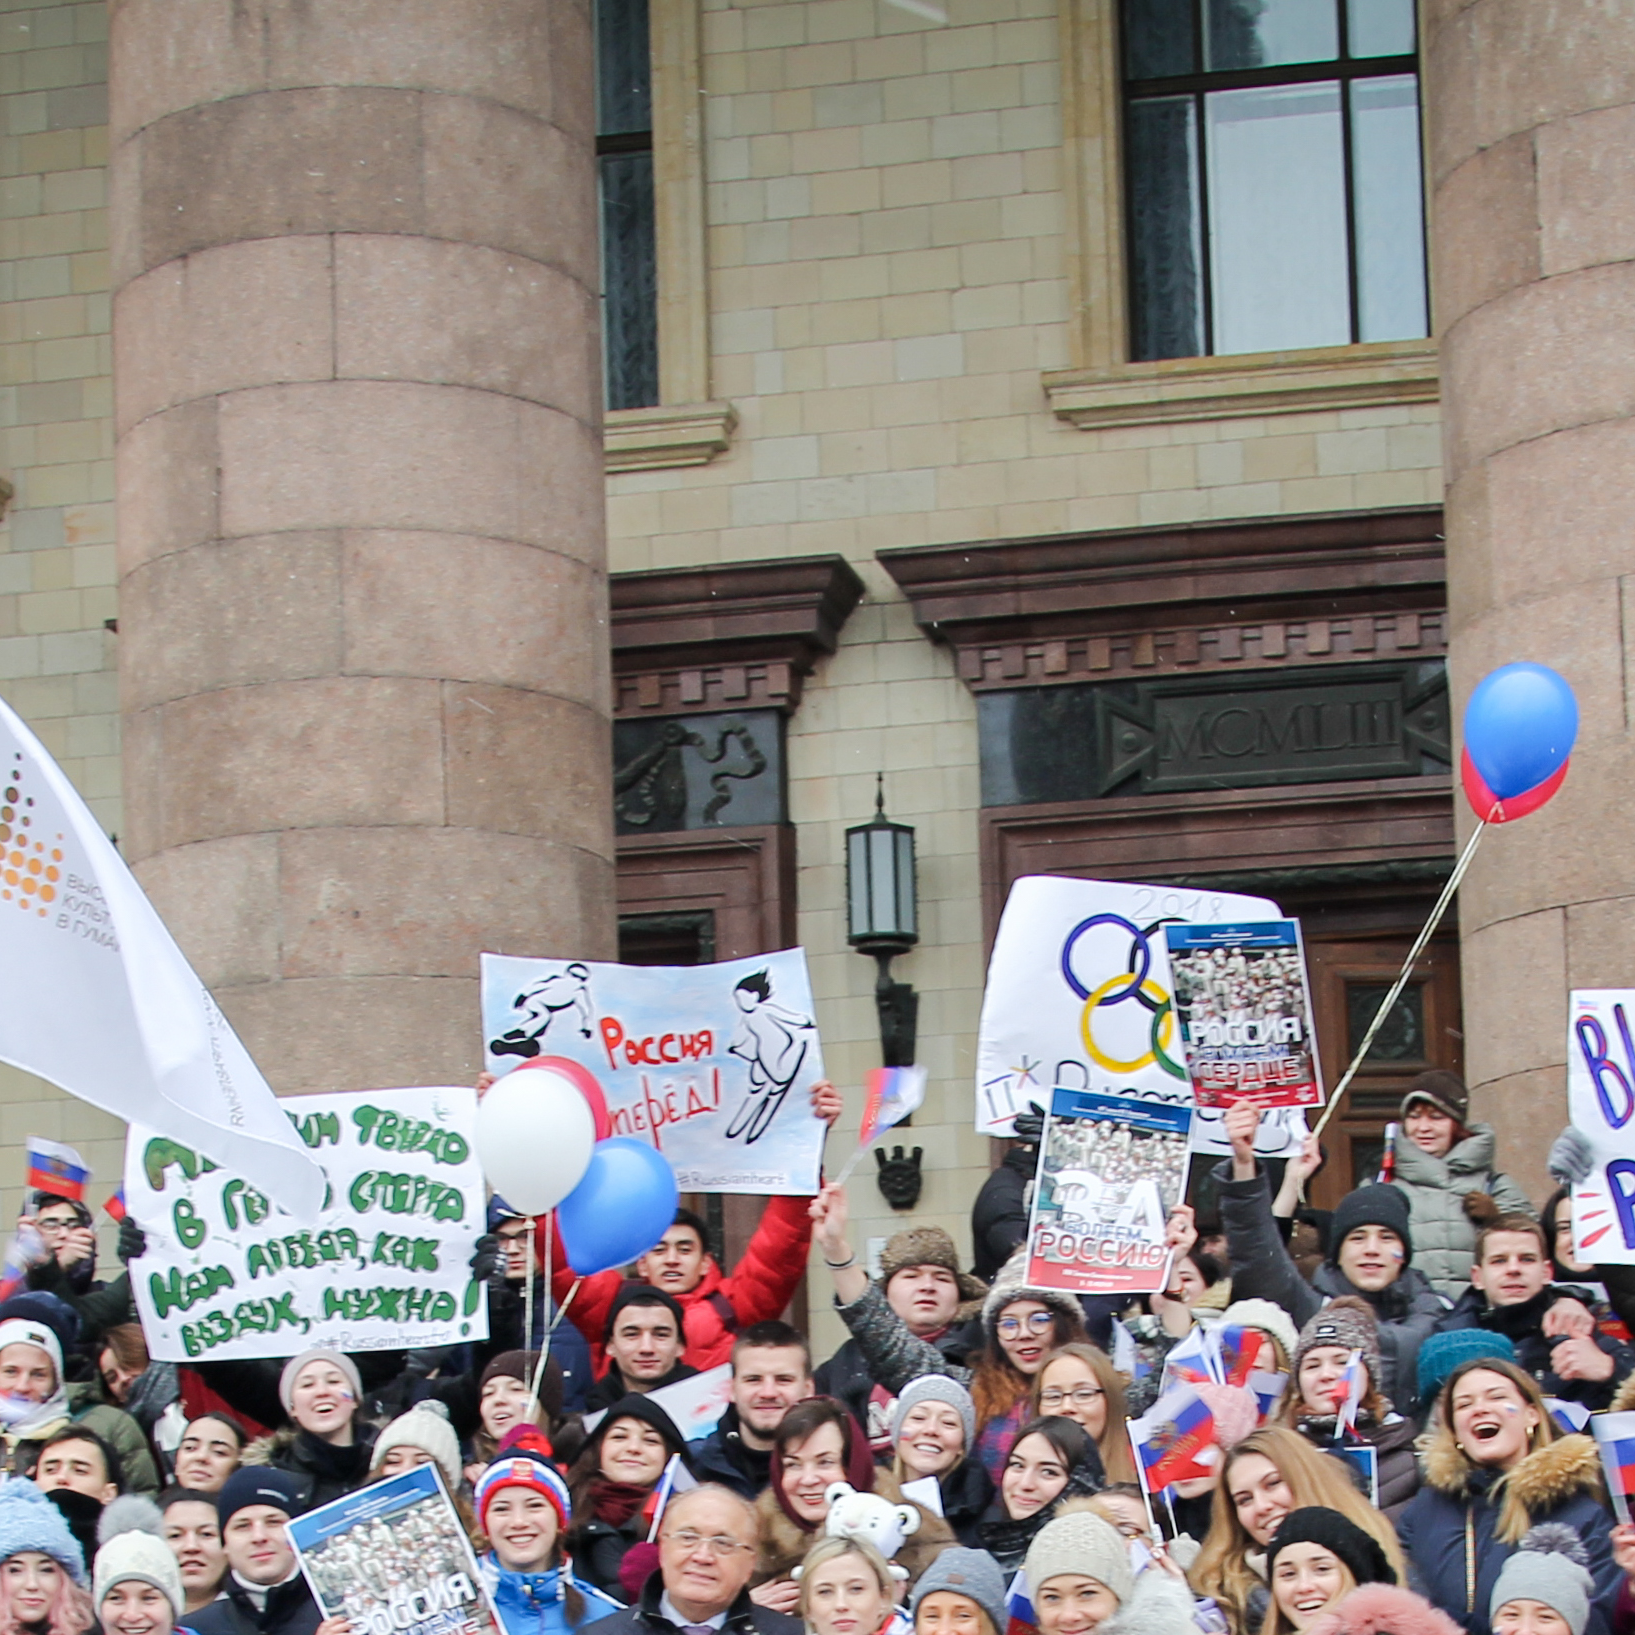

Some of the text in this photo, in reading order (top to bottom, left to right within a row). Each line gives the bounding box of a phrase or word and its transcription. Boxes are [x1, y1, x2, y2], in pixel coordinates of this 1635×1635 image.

[1160, 699, 1401, 762] MCMLIII
[1128, 887, 1225, 923] 2018
[1187, 1016, 1304, 1047] РОССИЯ
[1195, 1054, 1302, 1091] СЕРДЦЕ
[1034, 1231, 1169, 1268] РОССИЮ
